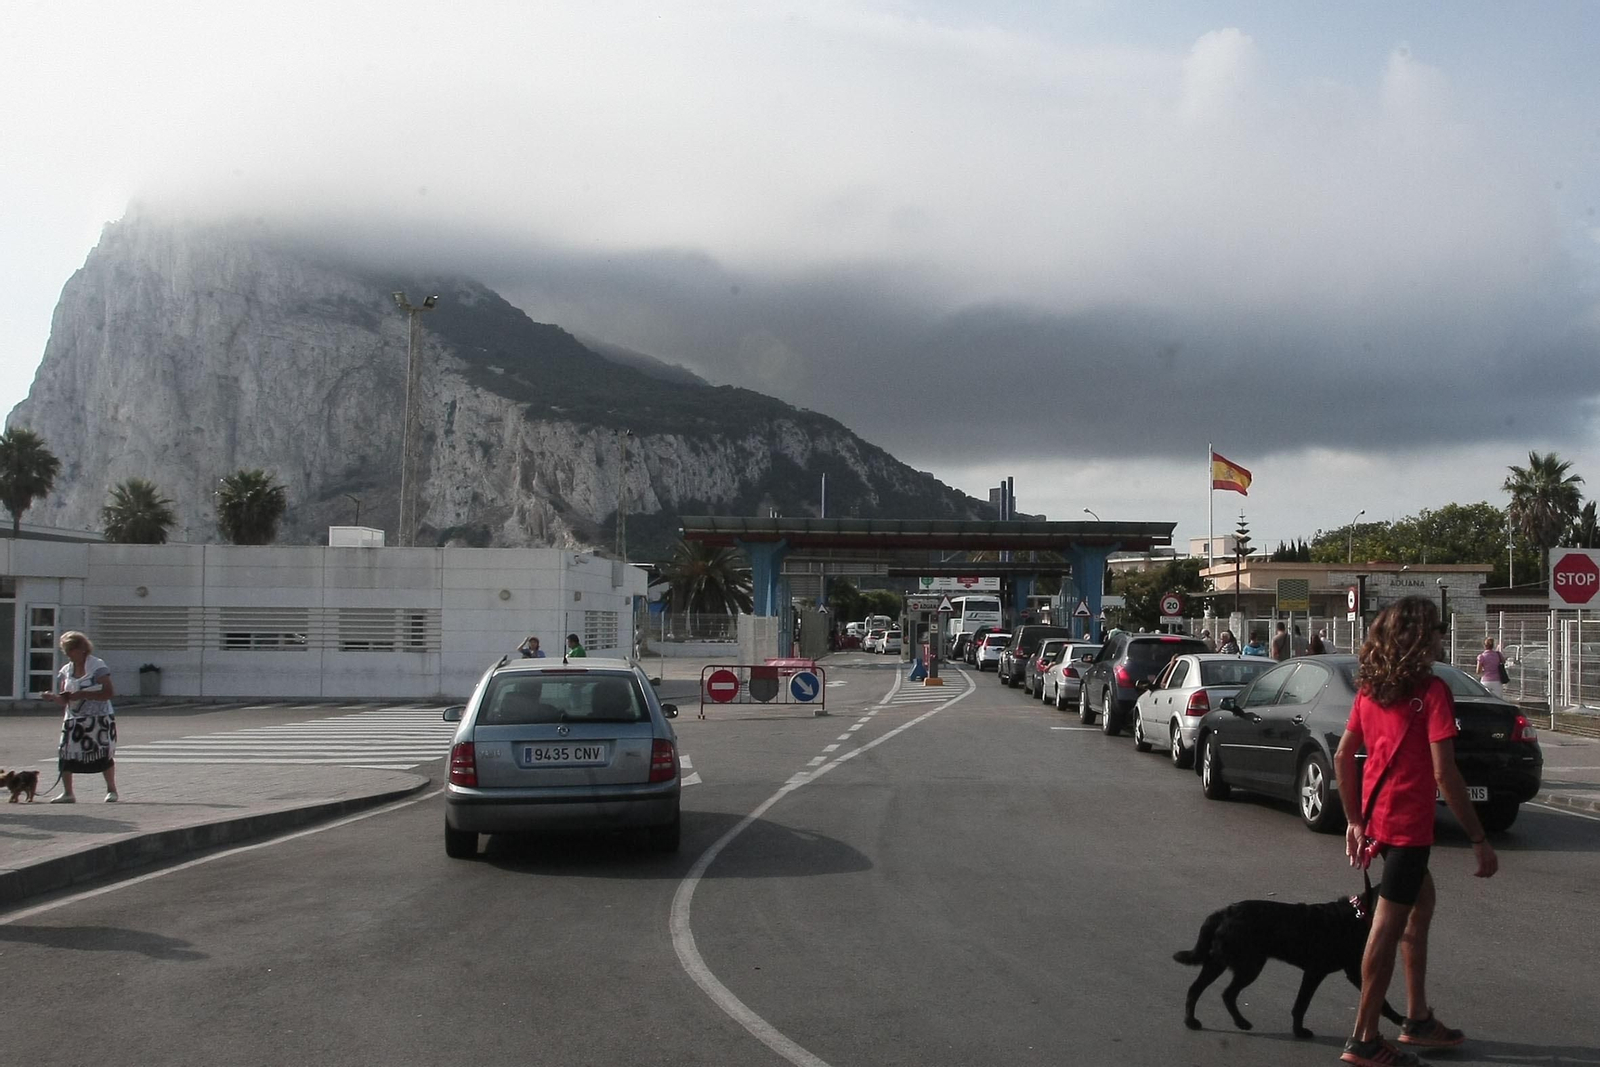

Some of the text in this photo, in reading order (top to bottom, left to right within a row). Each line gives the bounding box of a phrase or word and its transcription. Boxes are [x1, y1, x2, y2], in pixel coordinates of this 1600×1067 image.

[1390, 579, 1425, 587] ADUANA
[1556, 572, 1596, 586] STOP
[1166, 602, 1178, 610] 20
[534, 747, 600, 761] 9435 CNV
